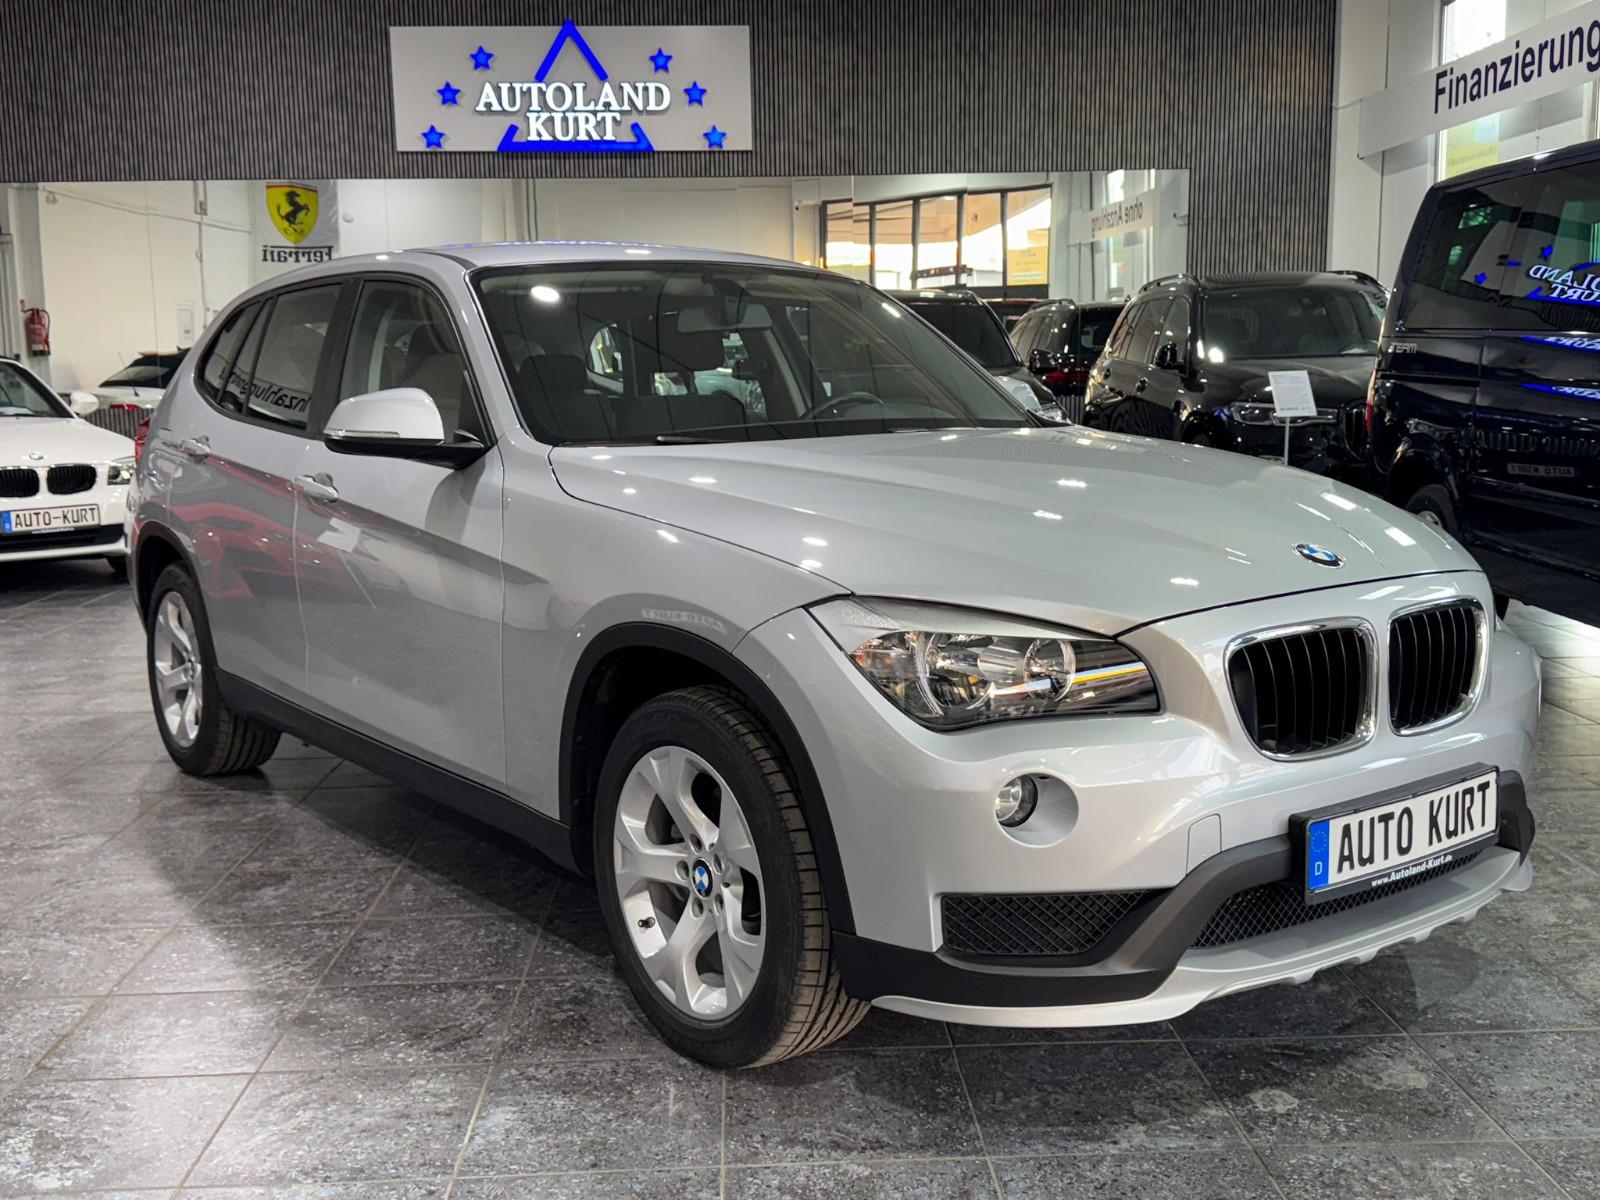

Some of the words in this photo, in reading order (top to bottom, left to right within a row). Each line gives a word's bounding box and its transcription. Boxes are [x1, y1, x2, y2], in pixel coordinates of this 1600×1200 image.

[1434, 19, 1600, 115] Finanzierung
[475, 82, 671, 112] AUTOLAND
[526, 112, 621, 142] KURT
[15, 507, 97, 529] AUTO-KURT
[1337, 806, 1413, 874] AUTO
[1428, 781, 1490, 846] KURT
[1315, 861, 1323, 876] D
[1371, 854, 1452, 887] www.Autoland-Kurt.de
